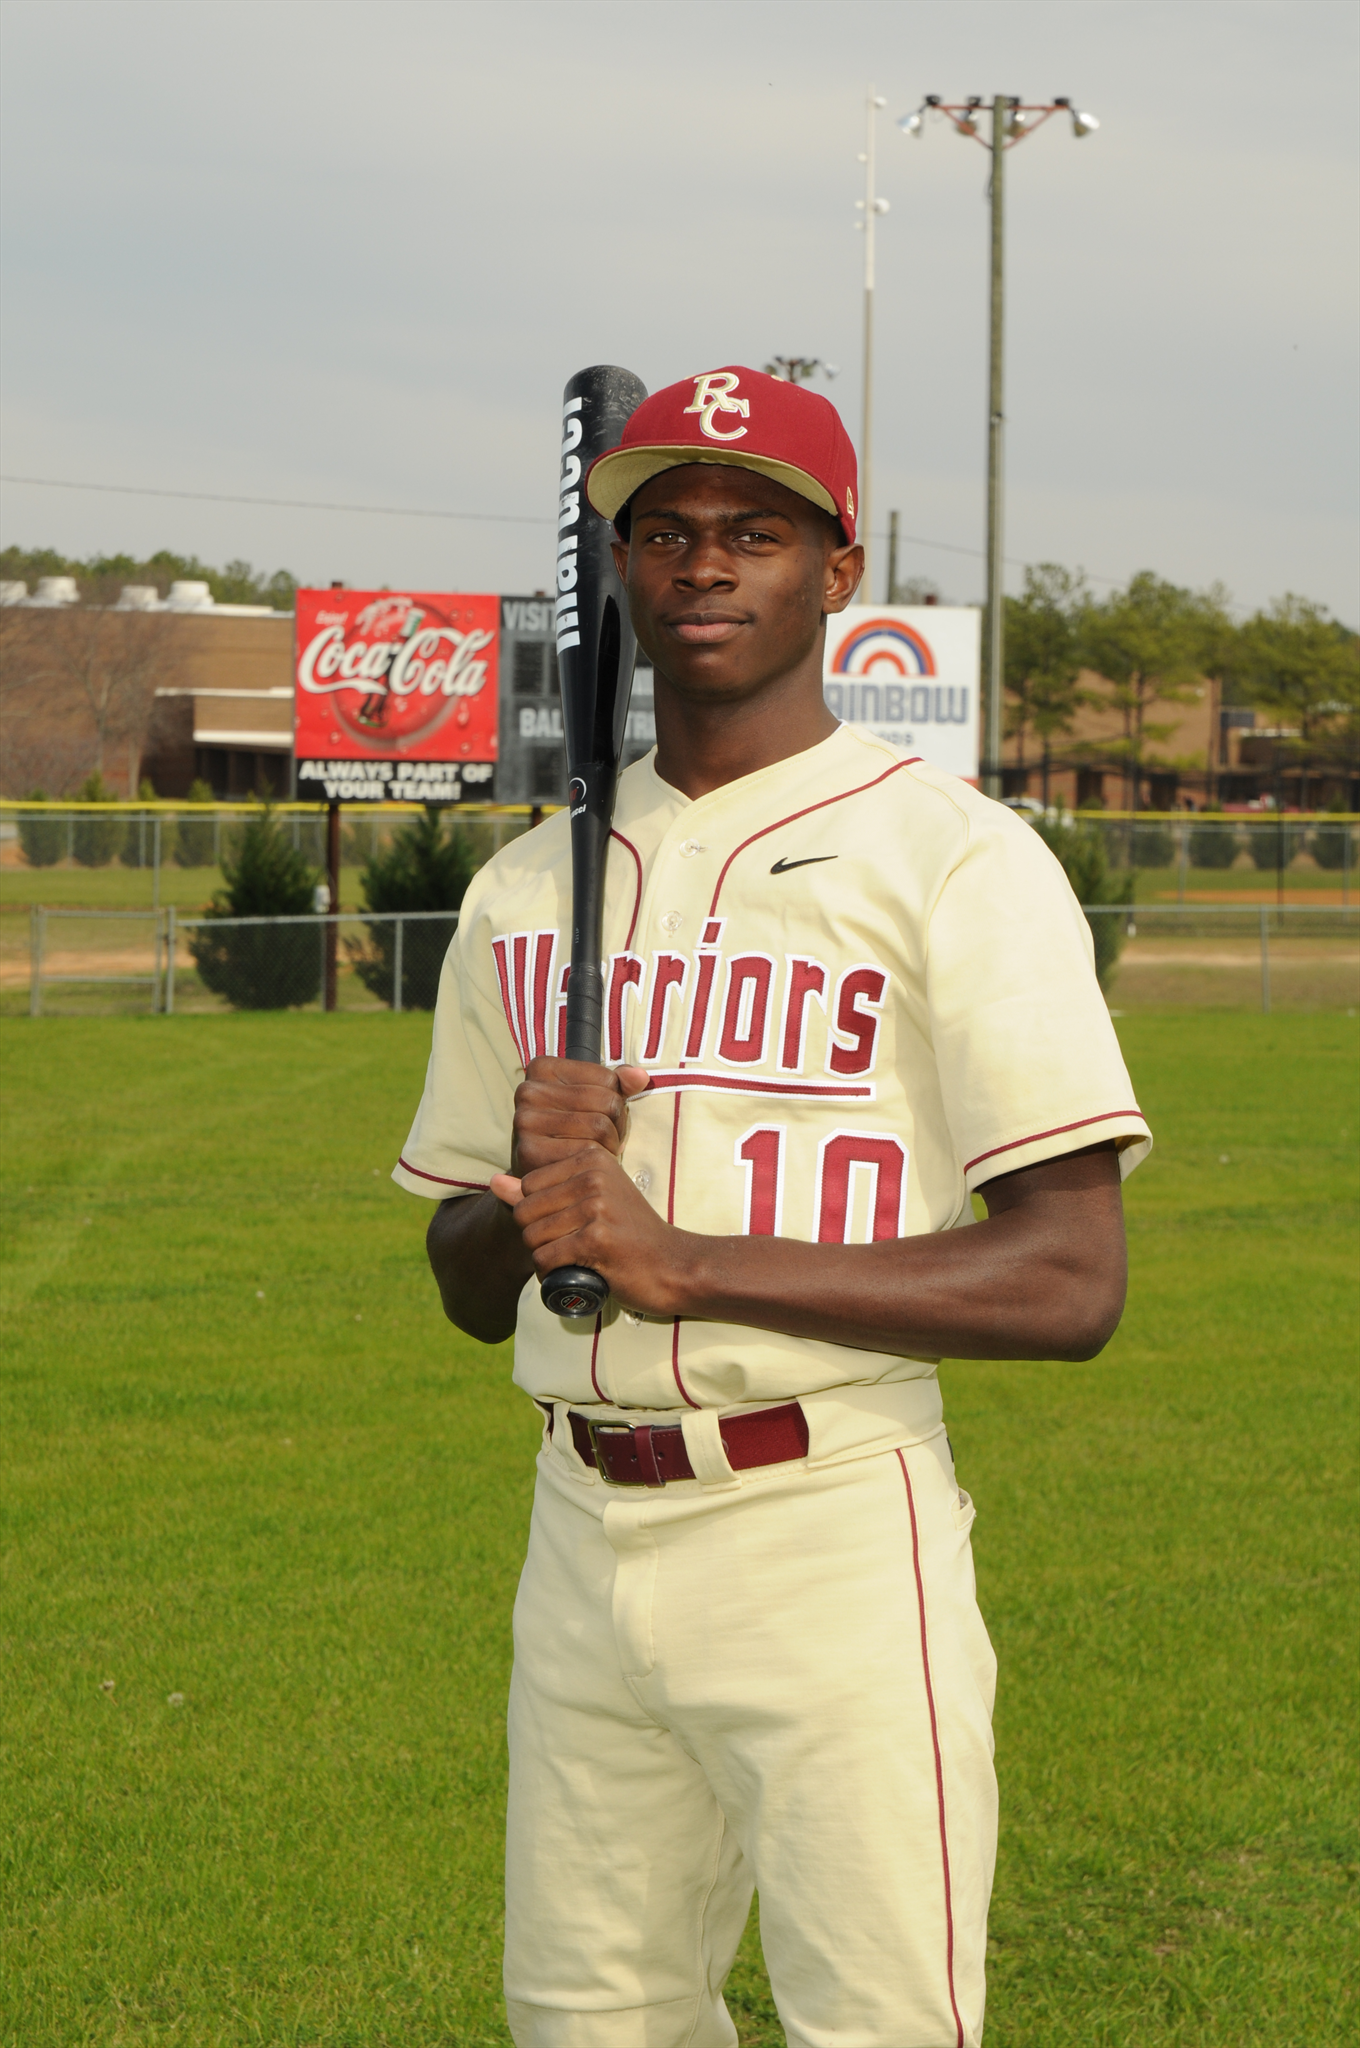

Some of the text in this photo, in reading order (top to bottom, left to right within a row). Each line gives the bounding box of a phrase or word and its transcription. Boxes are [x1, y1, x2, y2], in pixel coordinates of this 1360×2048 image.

[298, 624, 494, 696] Coca-Cola
[299, 761, 493, 784] ALWAYS PART OF
[324, 780, 461, 800] YOUR TEAM!
[734, 1124, 909, 1244] 10
